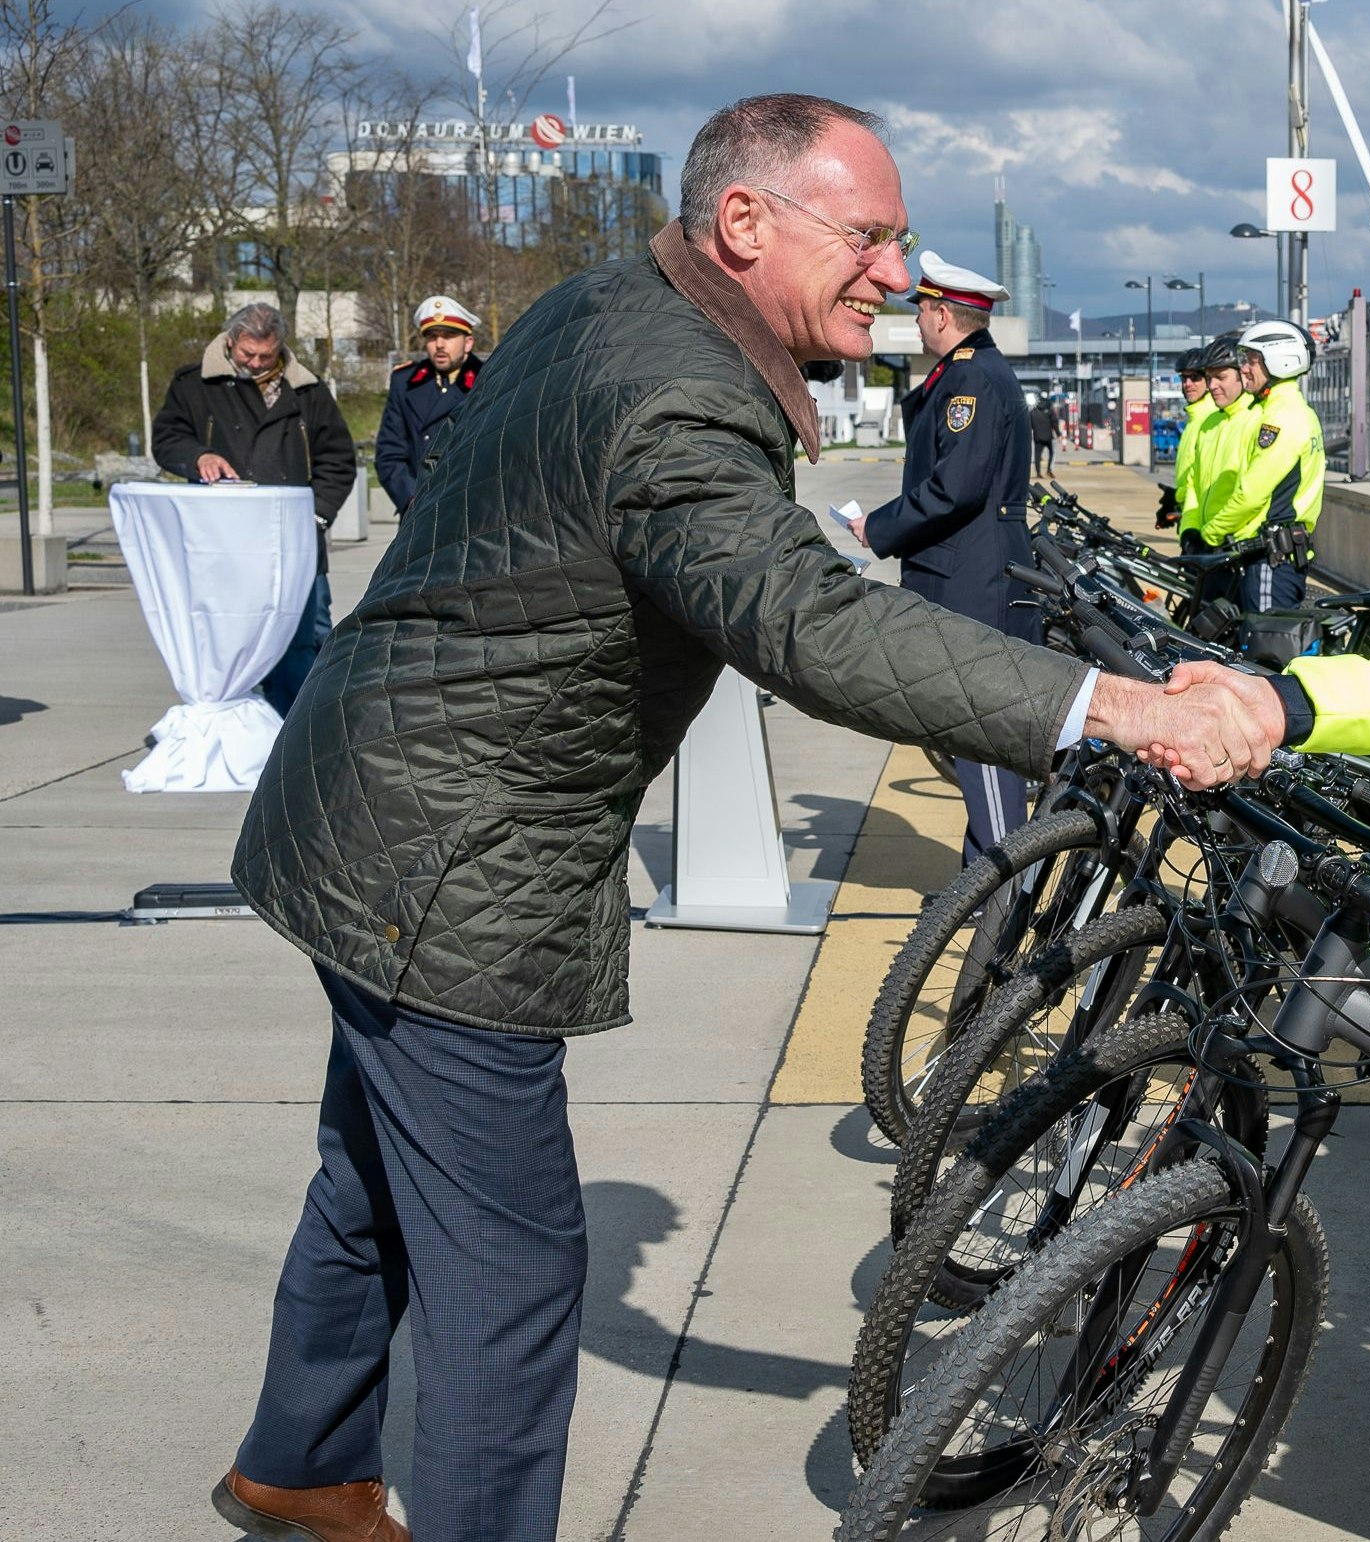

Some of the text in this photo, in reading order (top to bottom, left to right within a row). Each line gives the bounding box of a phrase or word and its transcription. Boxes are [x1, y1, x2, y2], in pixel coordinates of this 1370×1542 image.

[572, 123, 636, 141] WIEN
[1291, 169, 1313, 221] 8
[1176, 1268, 1209, 1322] RAY
